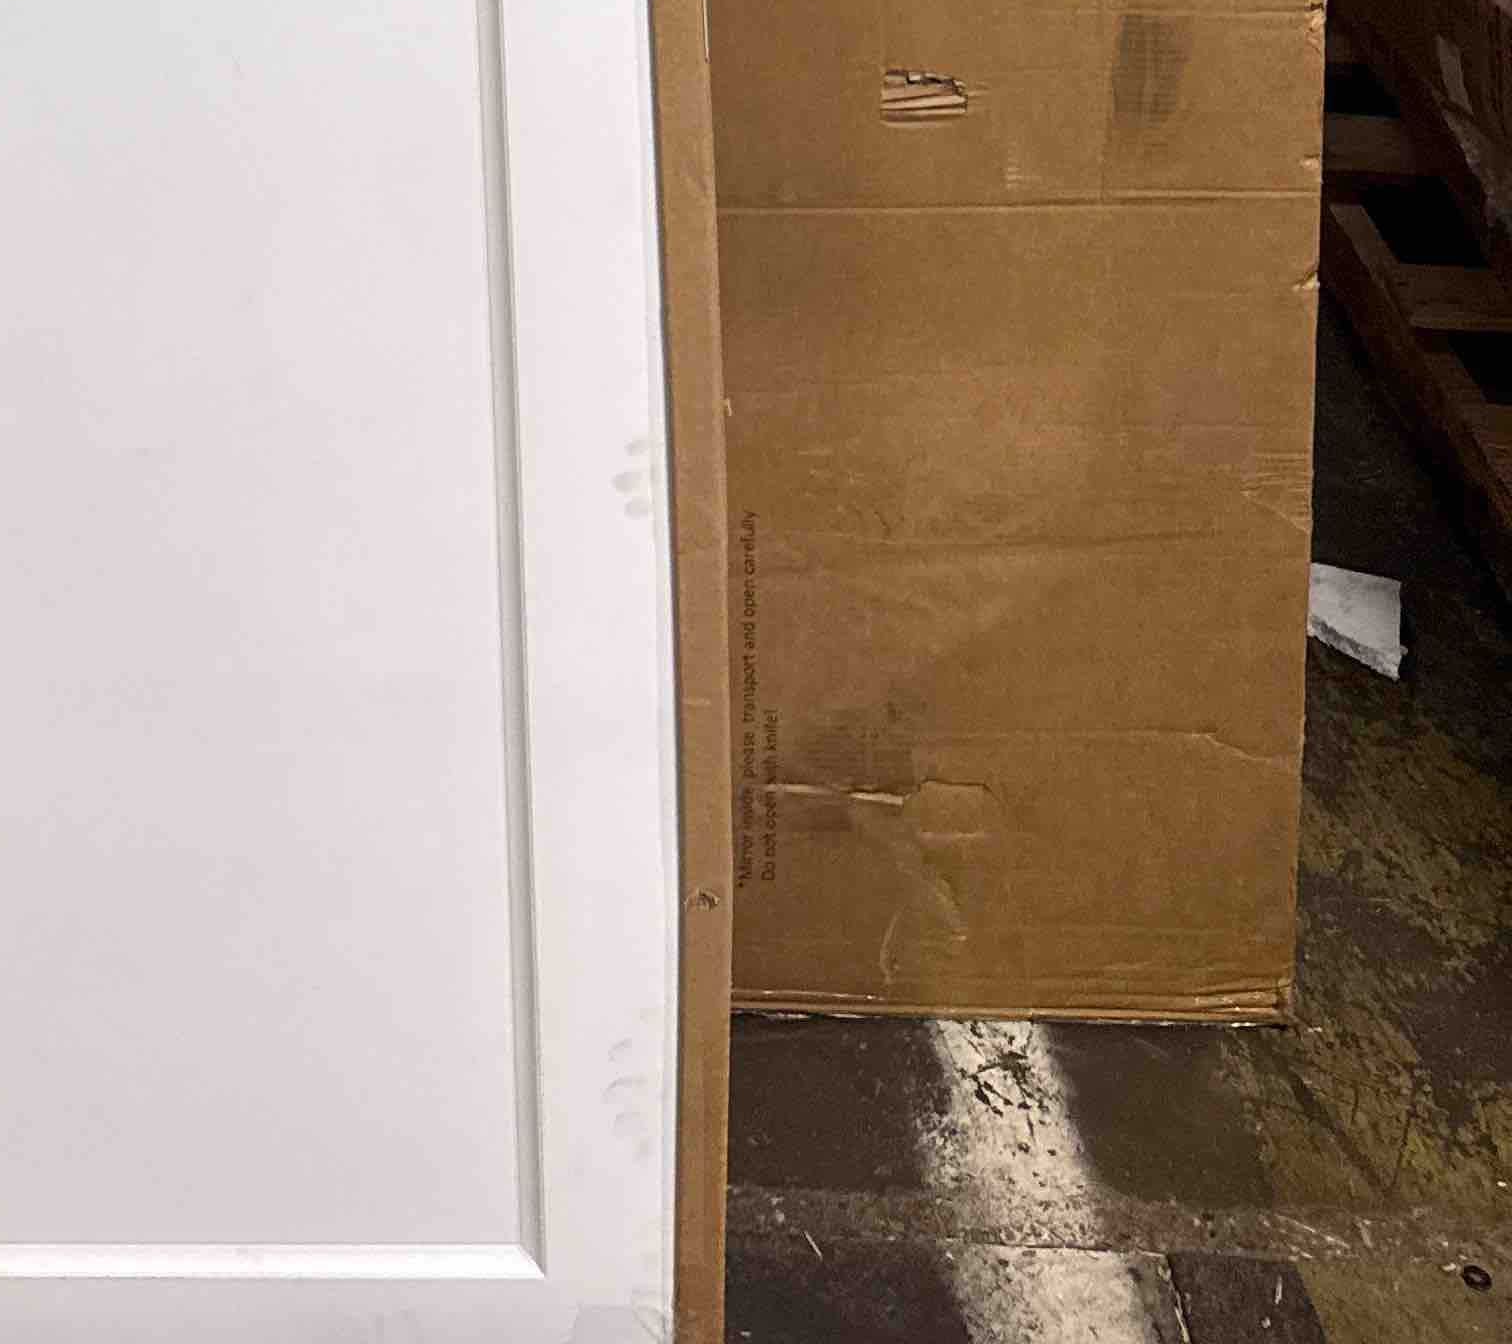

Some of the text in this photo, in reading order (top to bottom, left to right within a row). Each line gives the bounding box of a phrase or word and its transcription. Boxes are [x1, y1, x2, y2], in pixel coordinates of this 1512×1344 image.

[740, 510, 759, 576] carefully
[742, 579, 758, 617] open
[741, 622, 756, 650] and
[740, 654, 759, 724] transport
[740, 731, 758, 779] please
